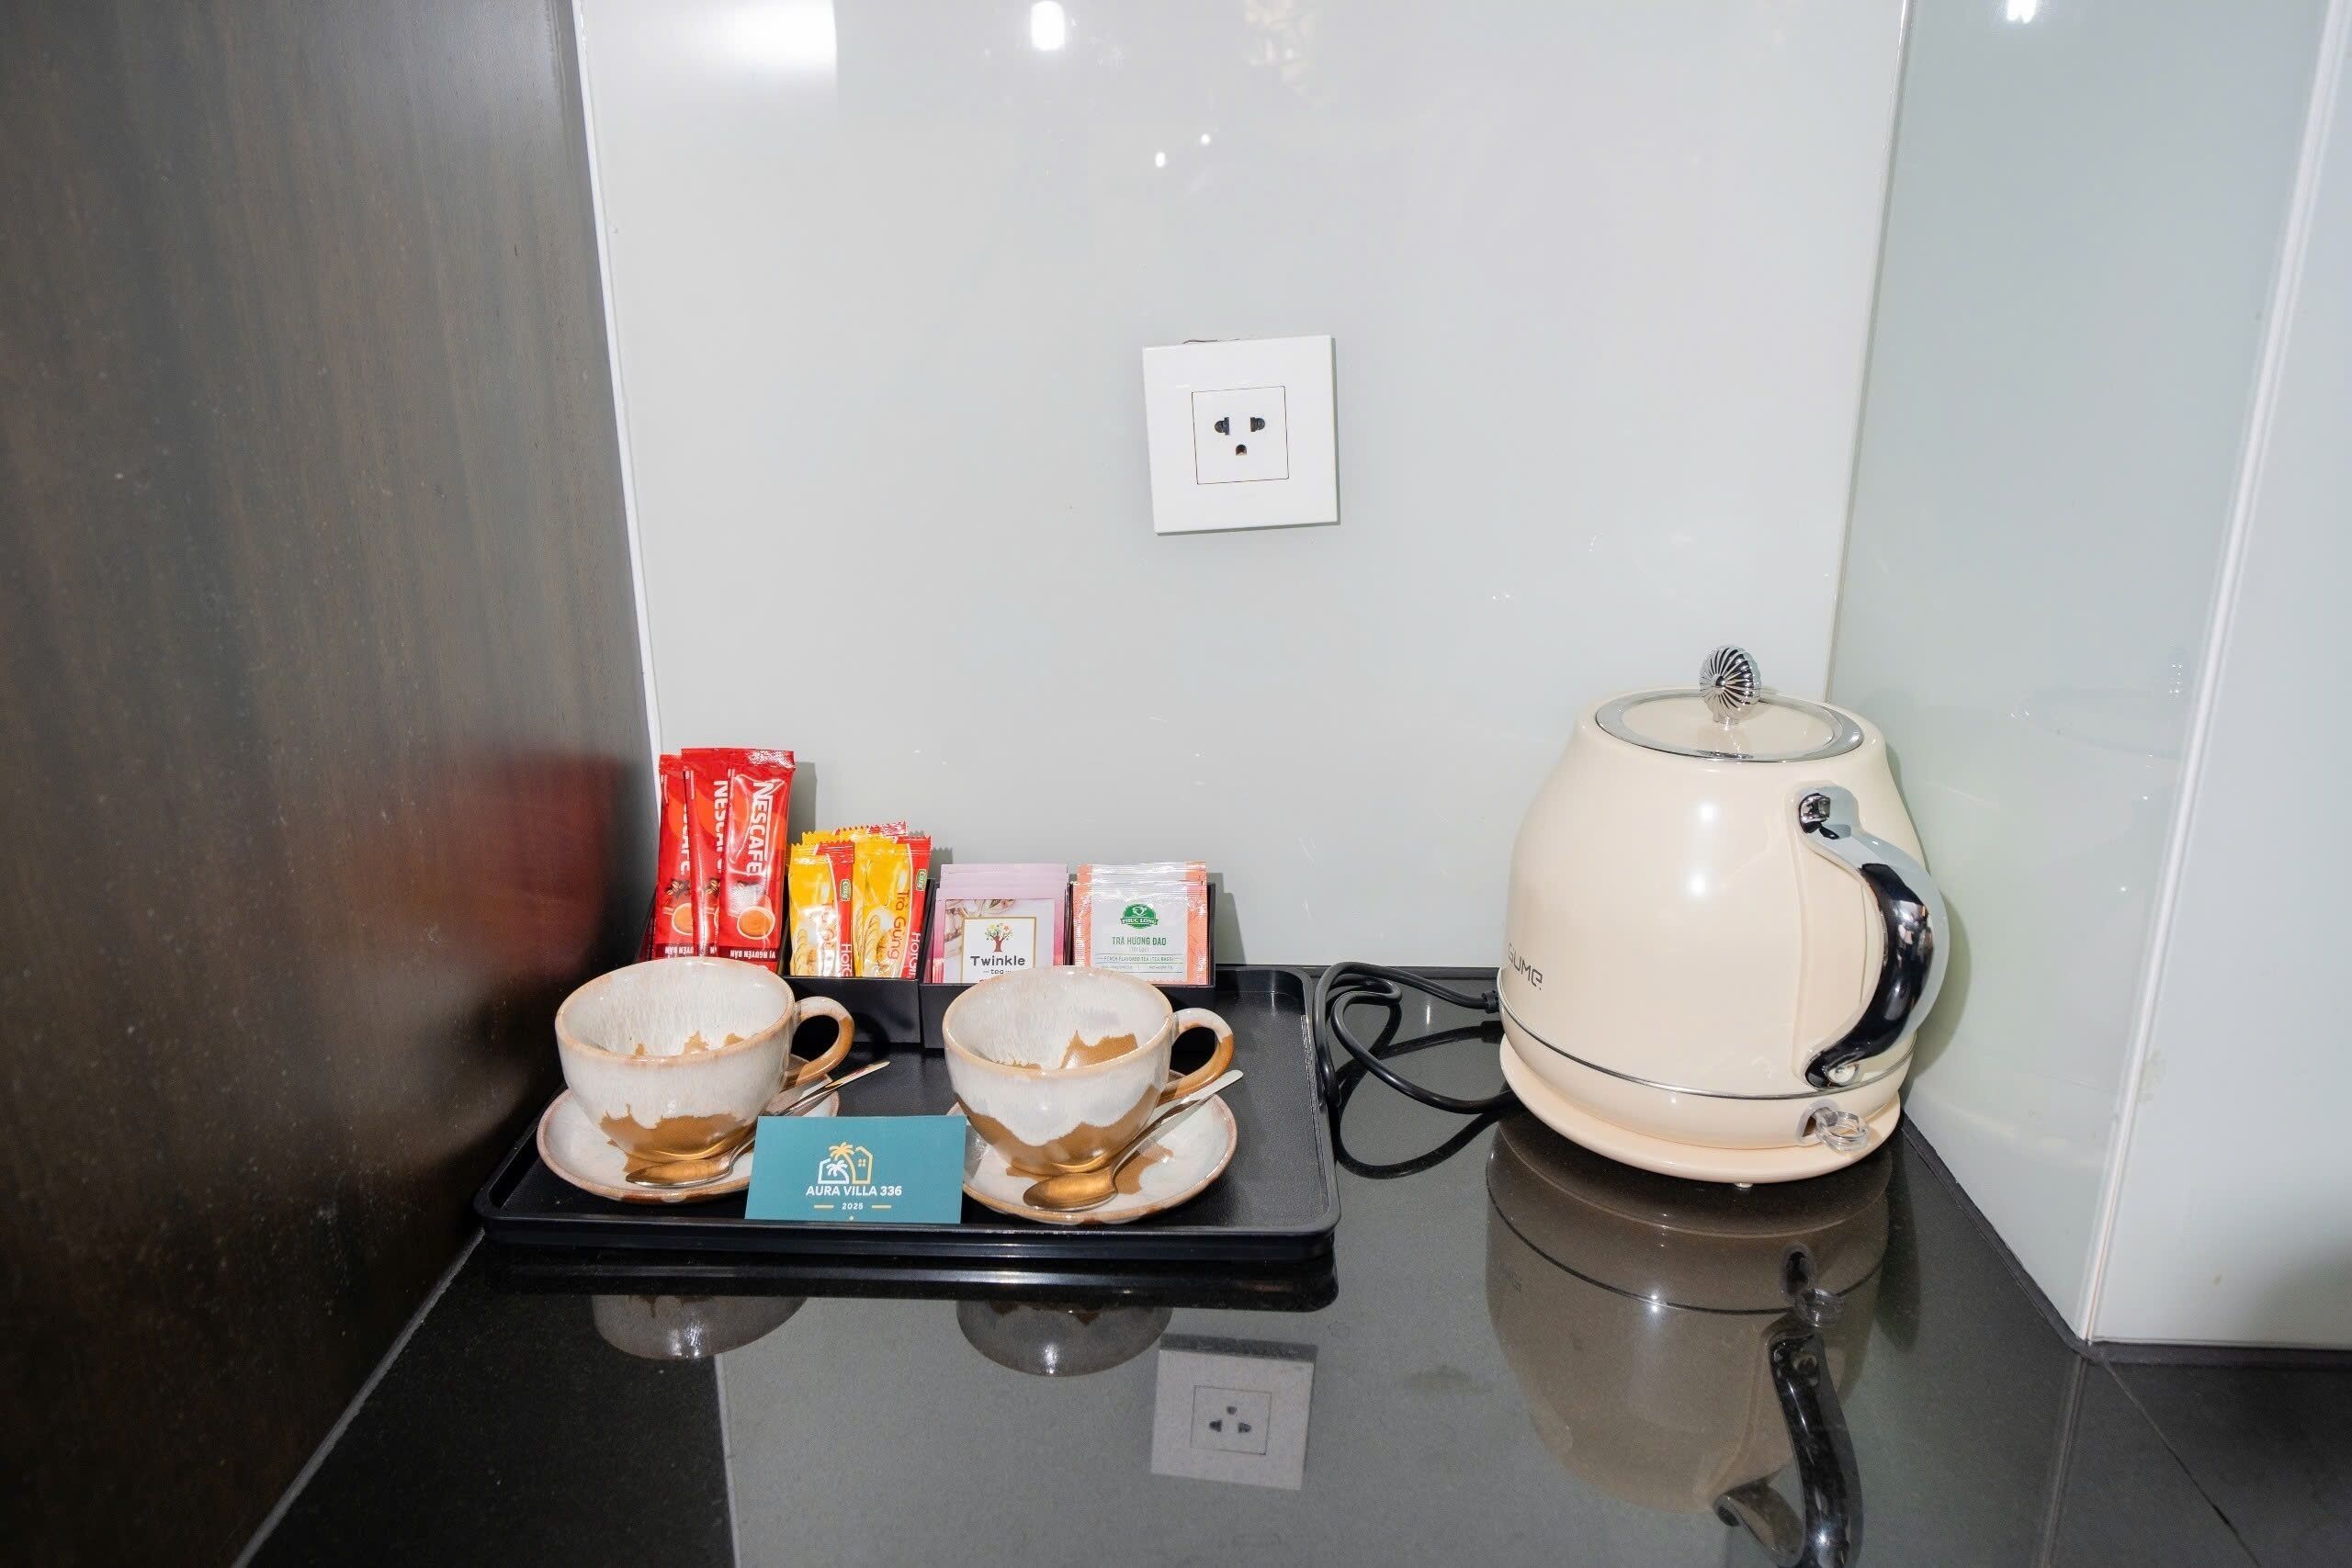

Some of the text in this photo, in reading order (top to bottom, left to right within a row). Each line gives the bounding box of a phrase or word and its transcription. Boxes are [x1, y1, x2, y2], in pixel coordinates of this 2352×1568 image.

[970, 955, 1025, 966] Twinkle
[806, 1186, 902, 1196] AURA VILLA 336
